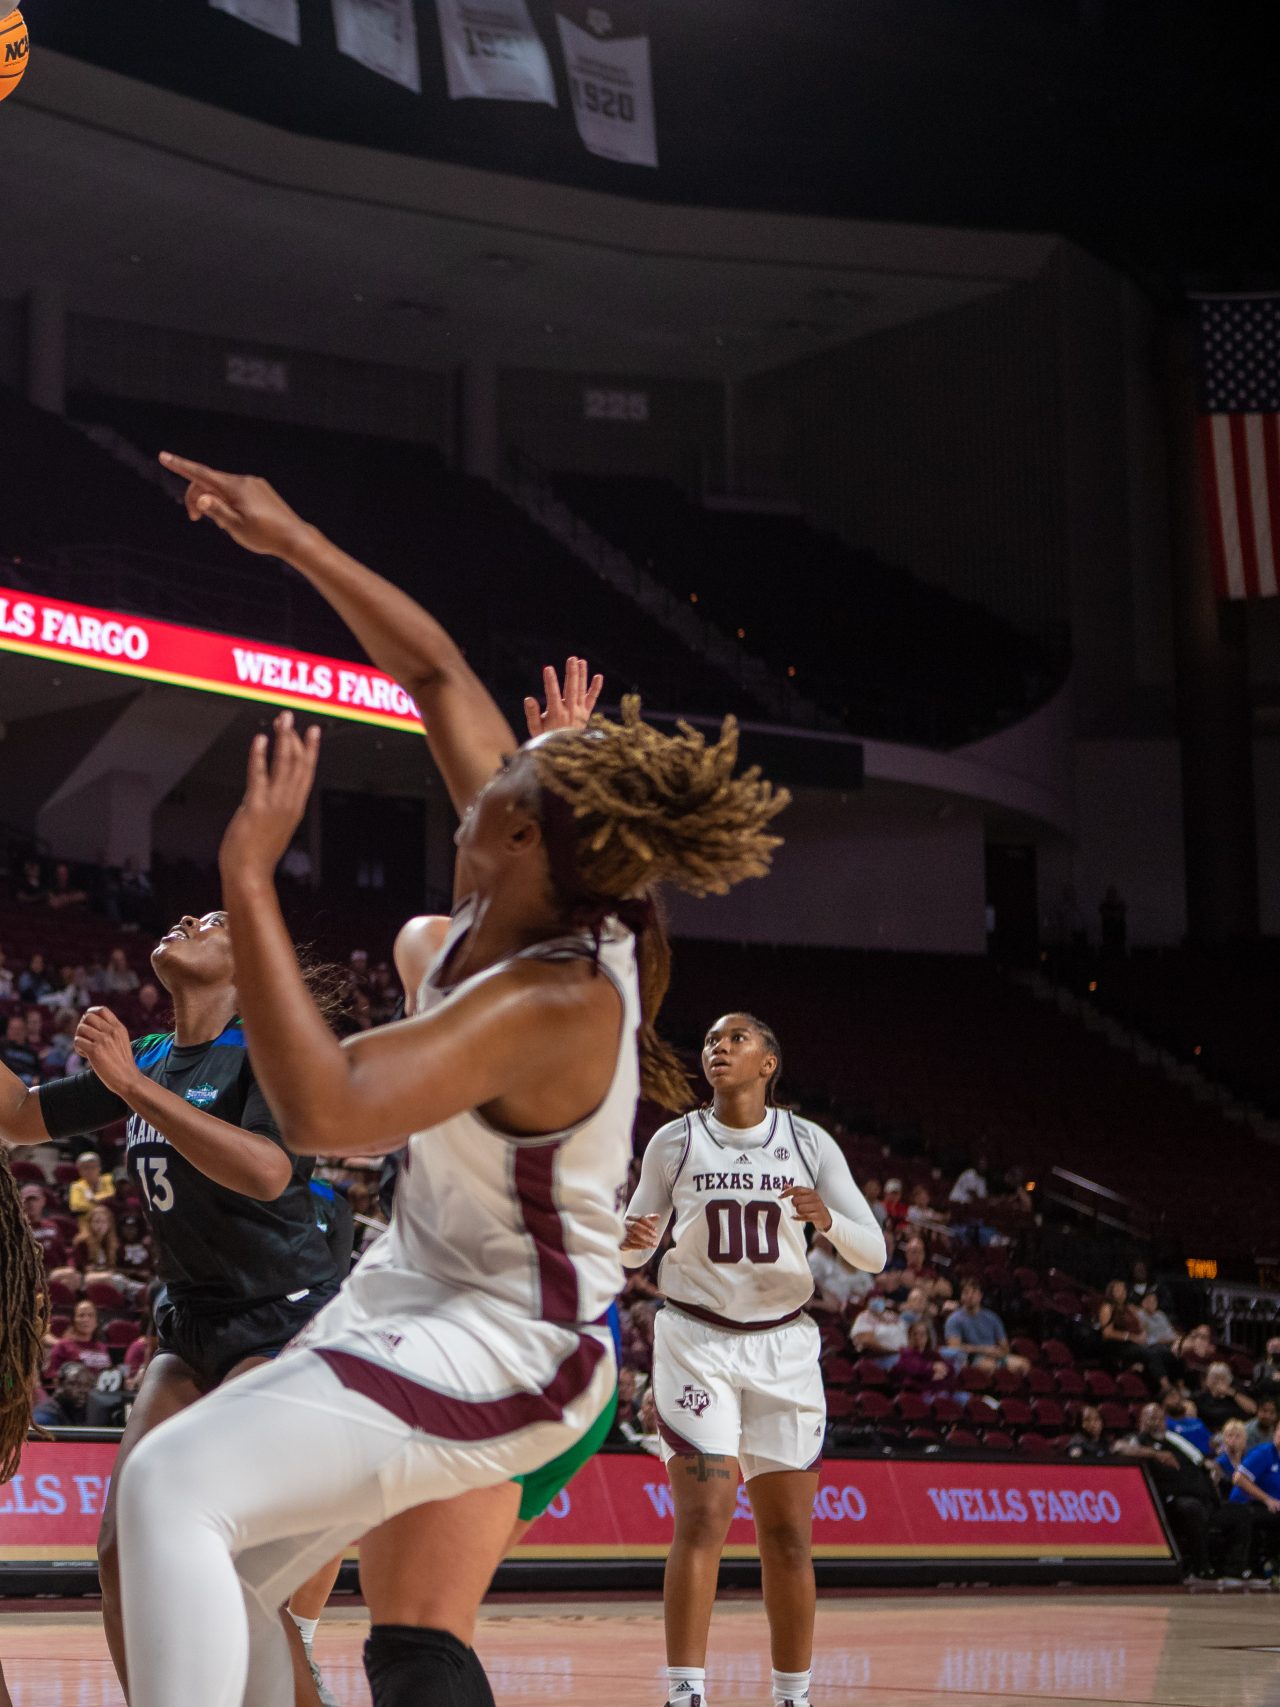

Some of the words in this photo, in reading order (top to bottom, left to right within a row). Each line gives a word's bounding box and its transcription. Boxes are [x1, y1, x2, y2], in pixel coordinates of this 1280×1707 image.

[41, 607, 149, 660] FARGO
[232, 647, 332, 698] WELLS
[136, 1157, 174, 1212] 13
[693, 1172, 753, 1192] TEXAS
[760, 1174, 795, 1191] A&M
[705, 1199, 782, 1264] 00
[927, 1488, 1029, 1523] WELLS
[1028, 1489, 1121, 1524] FARGO
